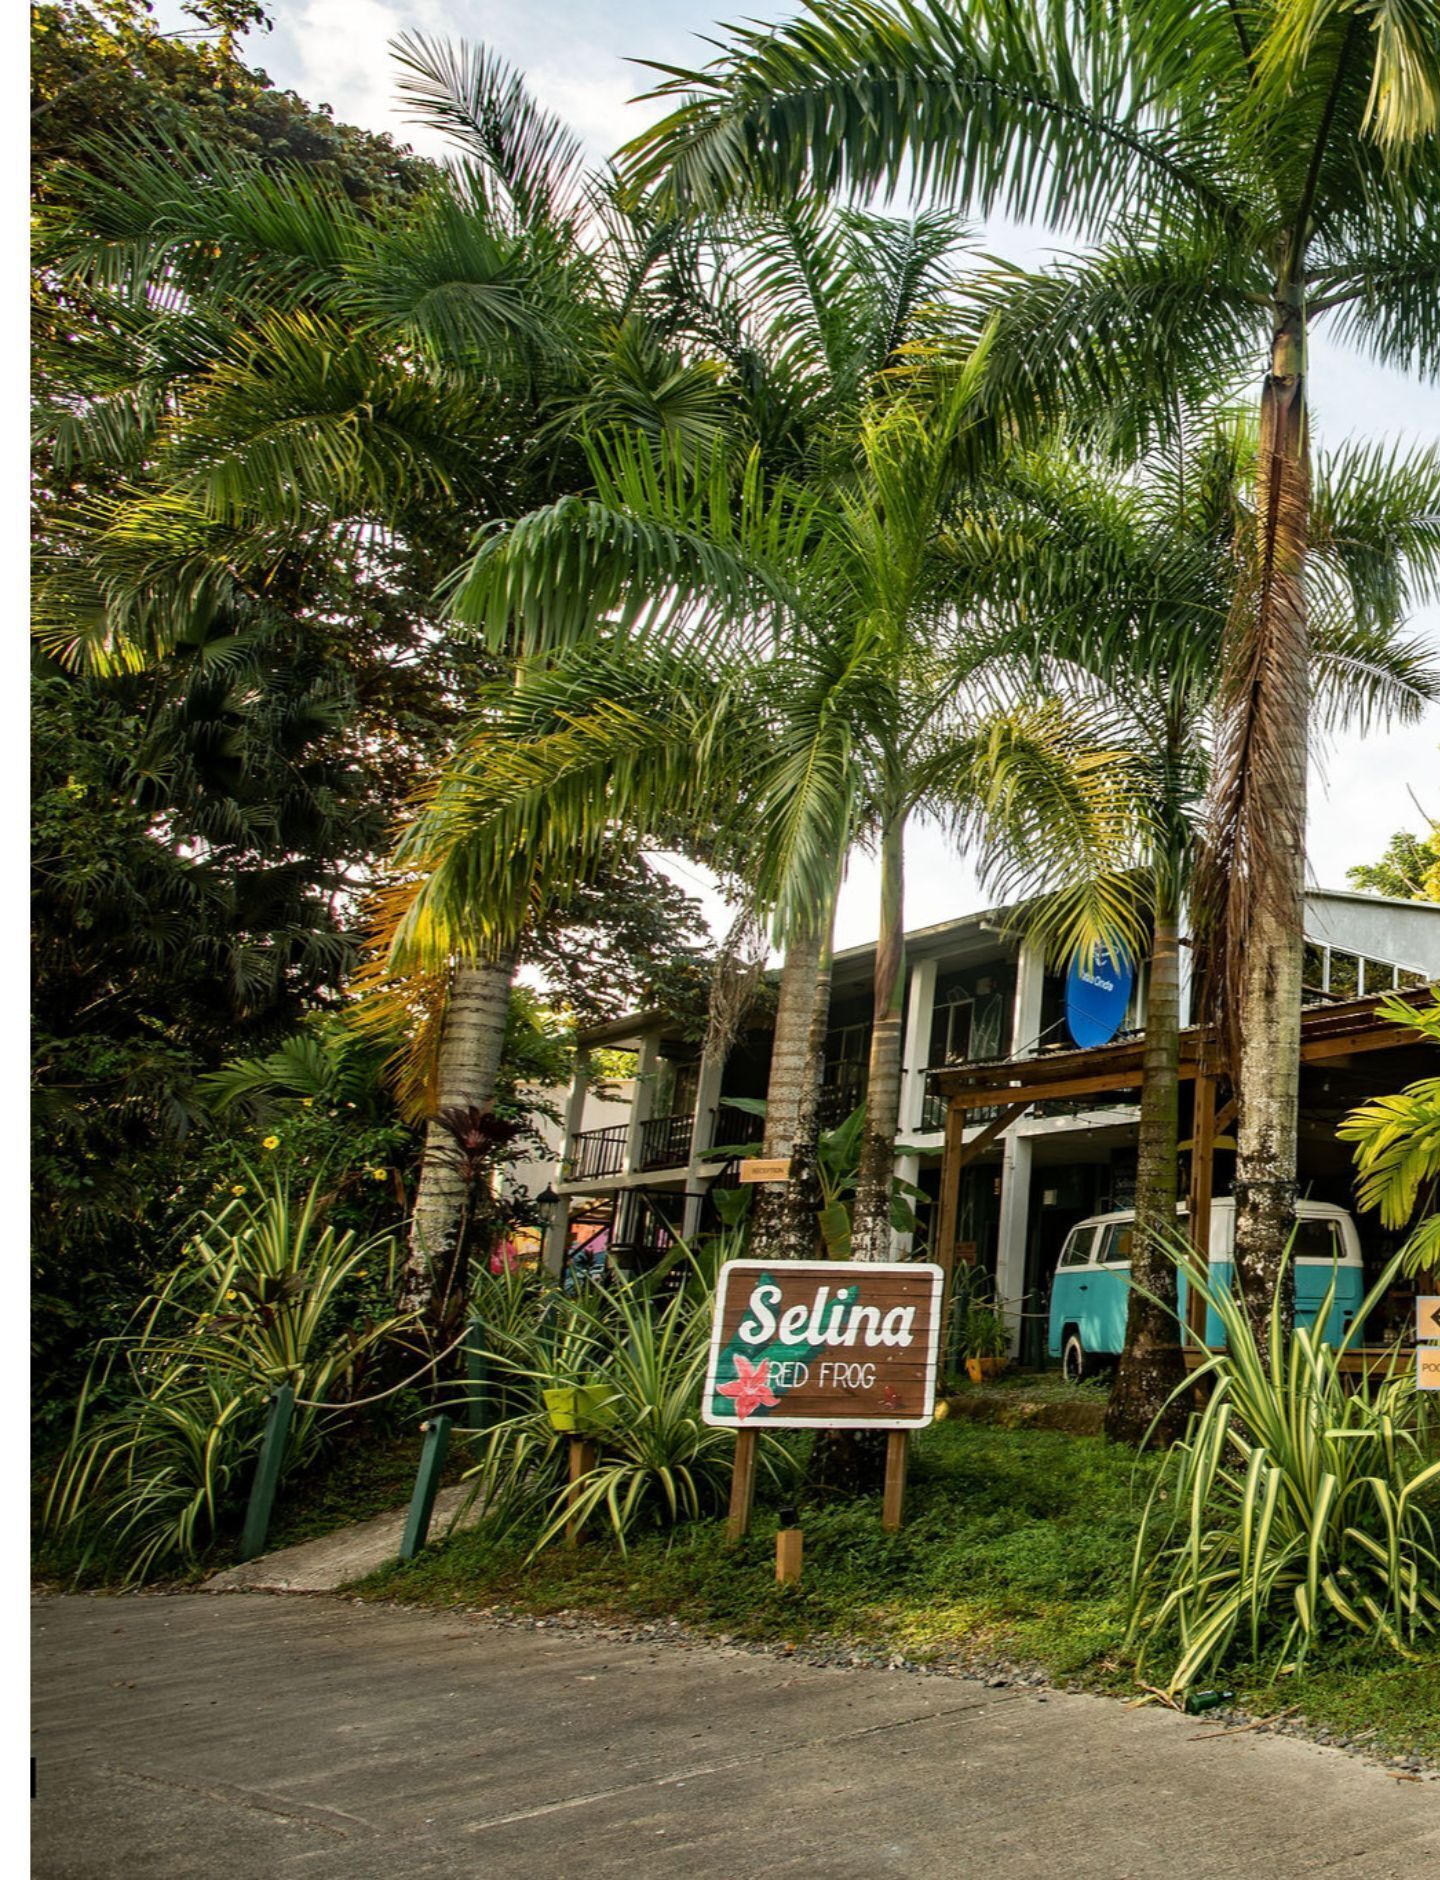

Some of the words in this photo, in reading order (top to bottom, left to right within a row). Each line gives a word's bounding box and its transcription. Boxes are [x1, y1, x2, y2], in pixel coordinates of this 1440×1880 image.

[738, 1284, 916, 1347] Selina
[767, 1361, 809, 1388] RED
[818, 1362, 877, 1389] FROG
